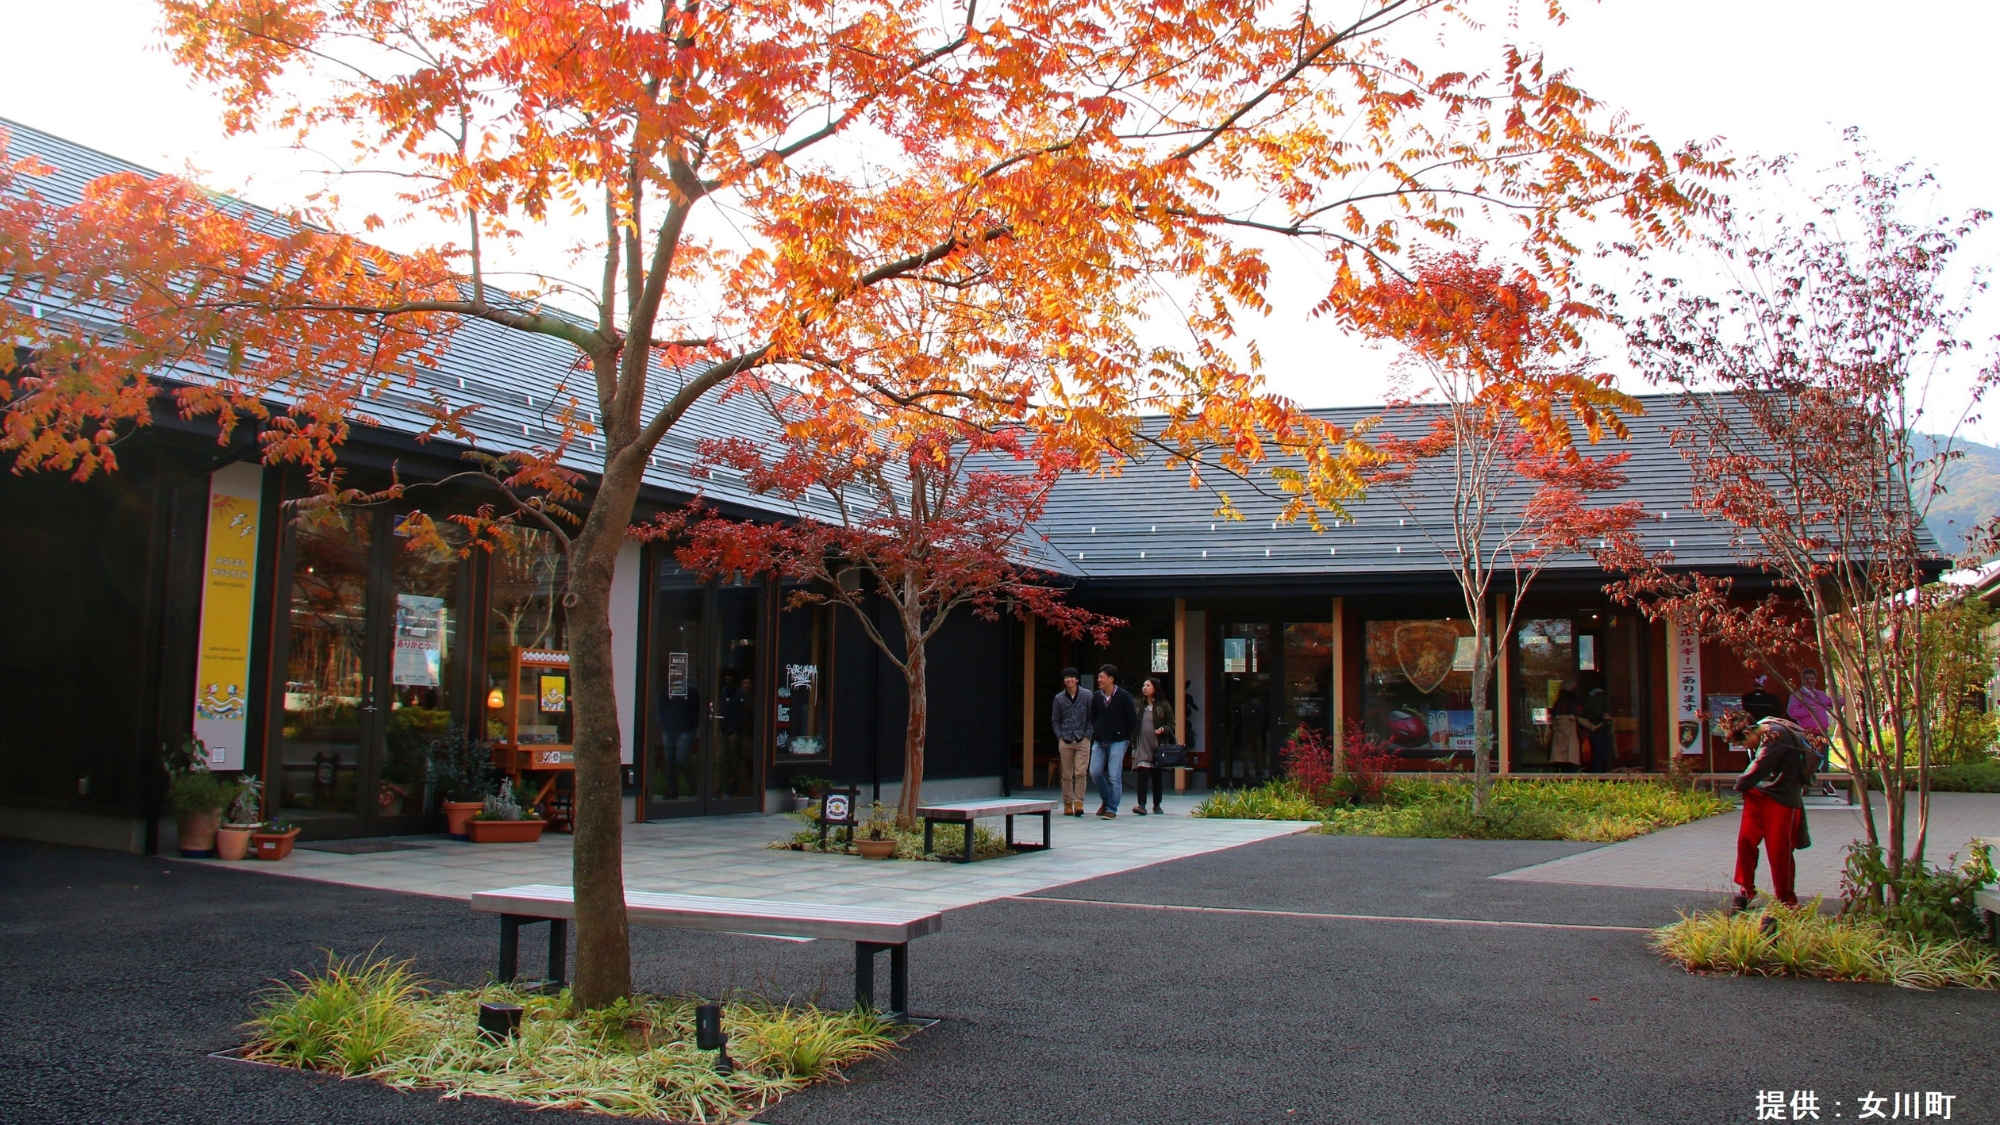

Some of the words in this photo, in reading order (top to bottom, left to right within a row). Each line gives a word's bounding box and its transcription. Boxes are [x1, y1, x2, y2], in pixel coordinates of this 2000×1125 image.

[1680, 618, 1698, 712] ボルギーニあります
